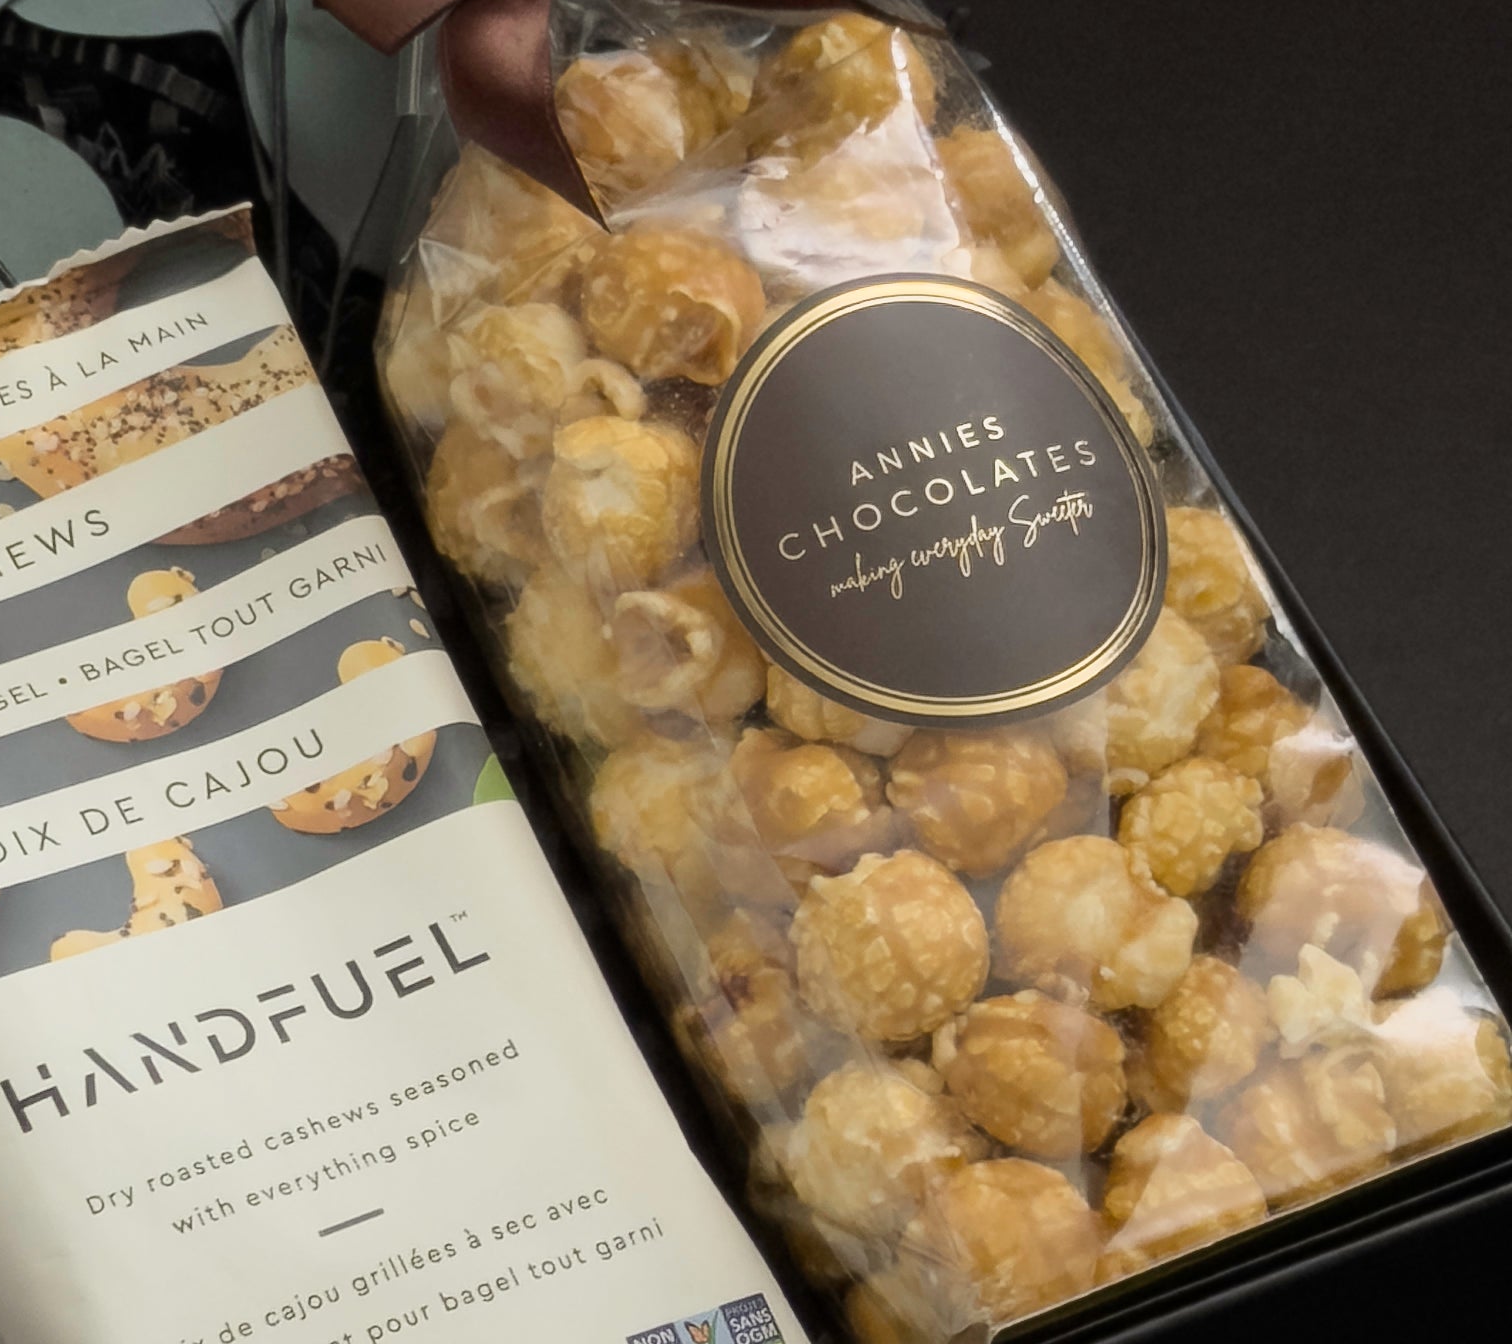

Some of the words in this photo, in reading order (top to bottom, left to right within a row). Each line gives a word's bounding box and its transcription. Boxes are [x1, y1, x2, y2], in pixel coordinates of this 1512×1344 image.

[44, 366, 67, 392] À
[83, 350, 118, 379] LA
[129, 312, 208, 354] MAIN
[778, 440, 1096, 560] CHOCOLATES
[849, 415, 1005, 486] ANNIES
[830, 553, 904, 598] making
[912, 515, 1006, 577] everyday
[1008, 490, 1092, 547] Sweeter
[78, 636, 183, 683] BAGEL
[190, 593, 275, 643] TOUT
[289, 543, 389, 598] GARNI
[79, 796, 144, 837] DE
[164, 728, 326, 809] CAJOU
[0, 921, 491, 1132] HANDFUEL
[87, 1181, 136, 1216] Dry
[146, 1139, 254, 1192] roasted
[264, 1098, 379, 1151] cashews
[389, 1040, 520, 1107] seasoned
[172, 1202, 238, 1235] with
[246, 1141, 398, 1208] everything
[406, 1108, 480, 1157] spice
[264, 1283, 341, 1331] cajou
[351, 1240, 458, 1299] grillées
[465, 1227, 483, 1250] à
[491, 1210, 538, 1241] sec
[546, 1186, 610, 1223] avec
[439, 1267, 520, 1314] bagel
[529, 1245, 587, 1281] tout
[595, 1217, 665, 1261] garni
[729, 1308, 772, 1332] SANS
